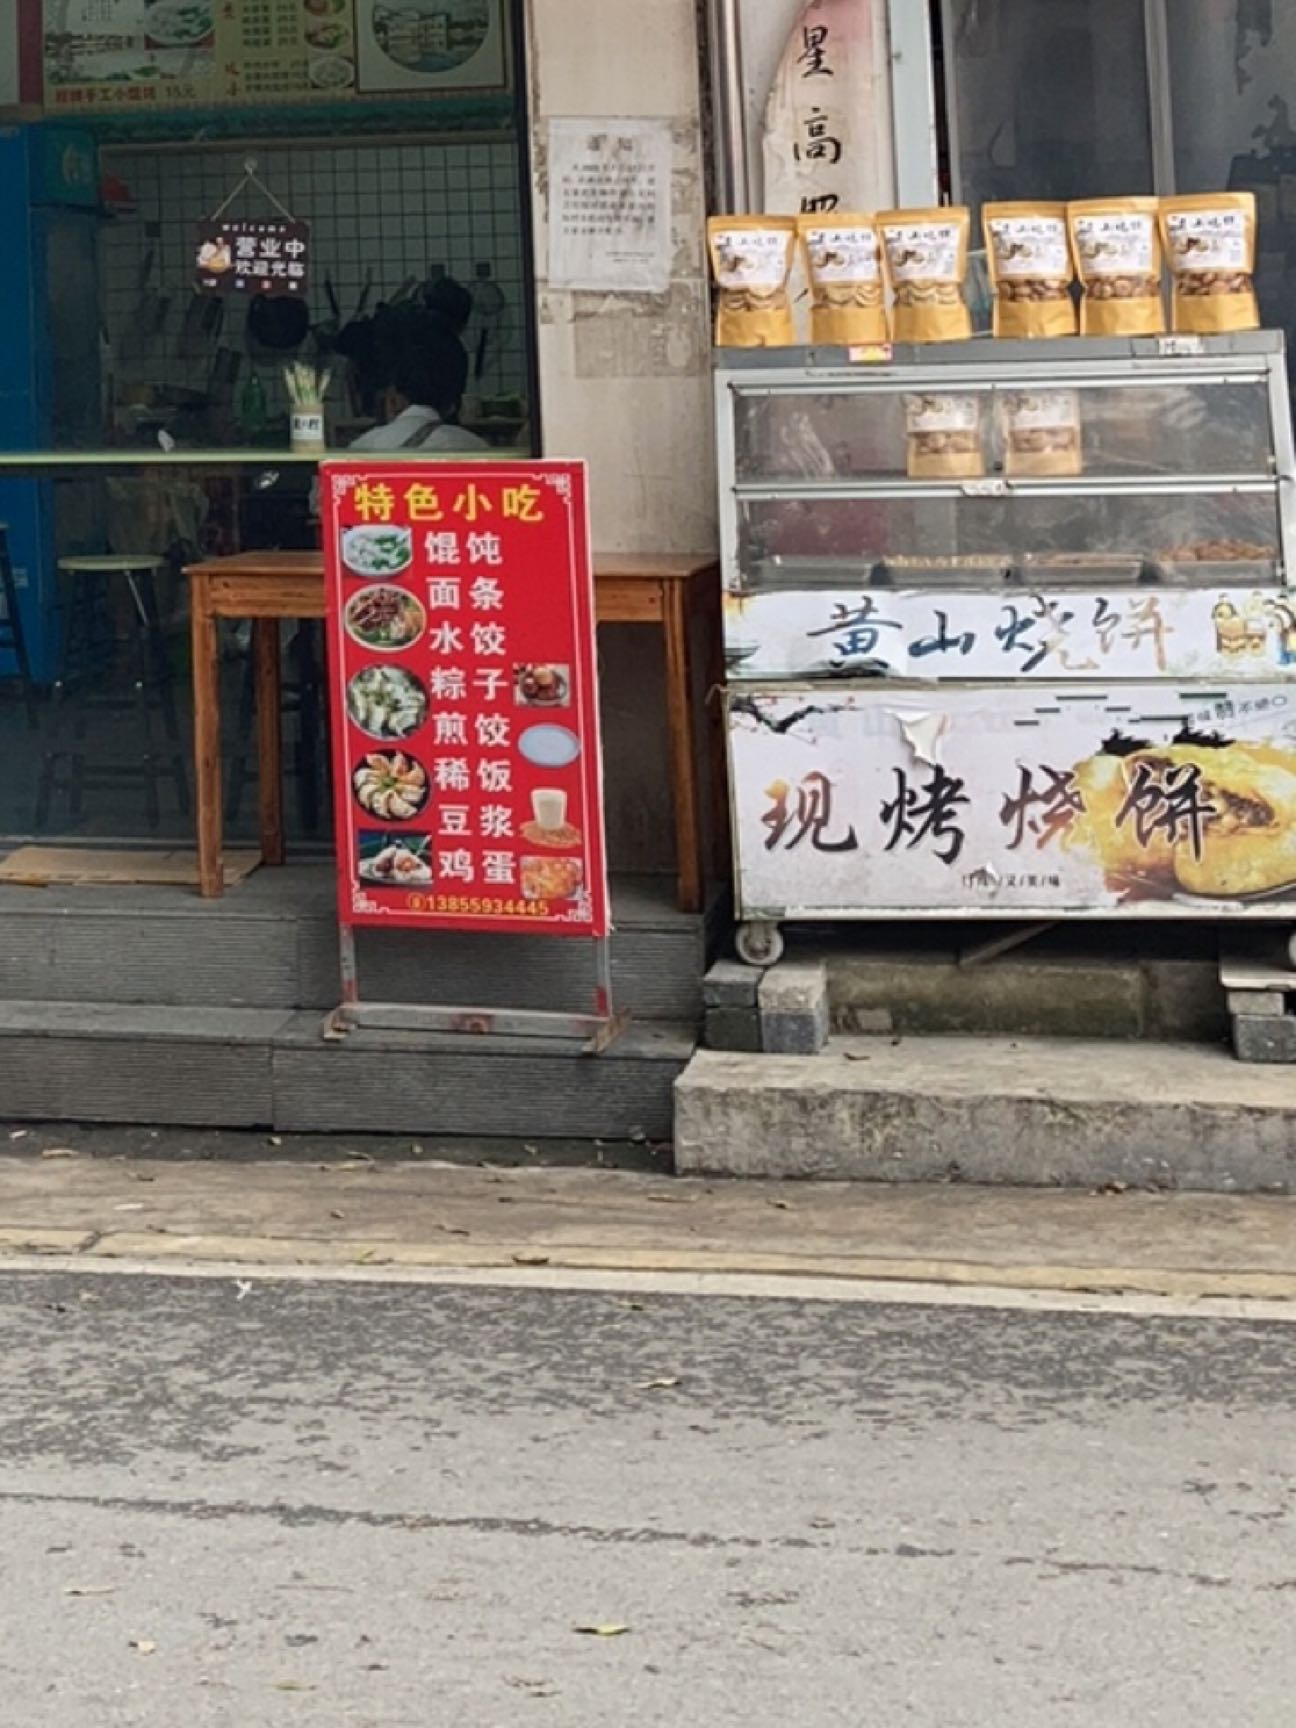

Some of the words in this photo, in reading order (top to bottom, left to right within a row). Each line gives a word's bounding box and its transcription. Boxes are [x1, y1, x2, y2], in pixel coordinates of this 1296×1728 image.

[235, 236, 306, 260] 营业中
[235, 259, 305, 278] 欢迎光临
[354, 483, 544, 522] 特色小吃
[425, 531, 503, 565] 馄饨
[426, 576, 504, 611] 面条
[429, 621, 506, 656] 水饺
[806, 594, 1175, 672] 黄山烧饼
[431, 666, 508, 701] 粽子
[433, 711, 510, 747] 煎饺
[434, 757, 512, 793] 稀饭
[438, 803, 514, 838] 豆浆
[761, 763, 1218, 863] 现烤烧饼
[439, 848, 516, 885] 鸡蛋
